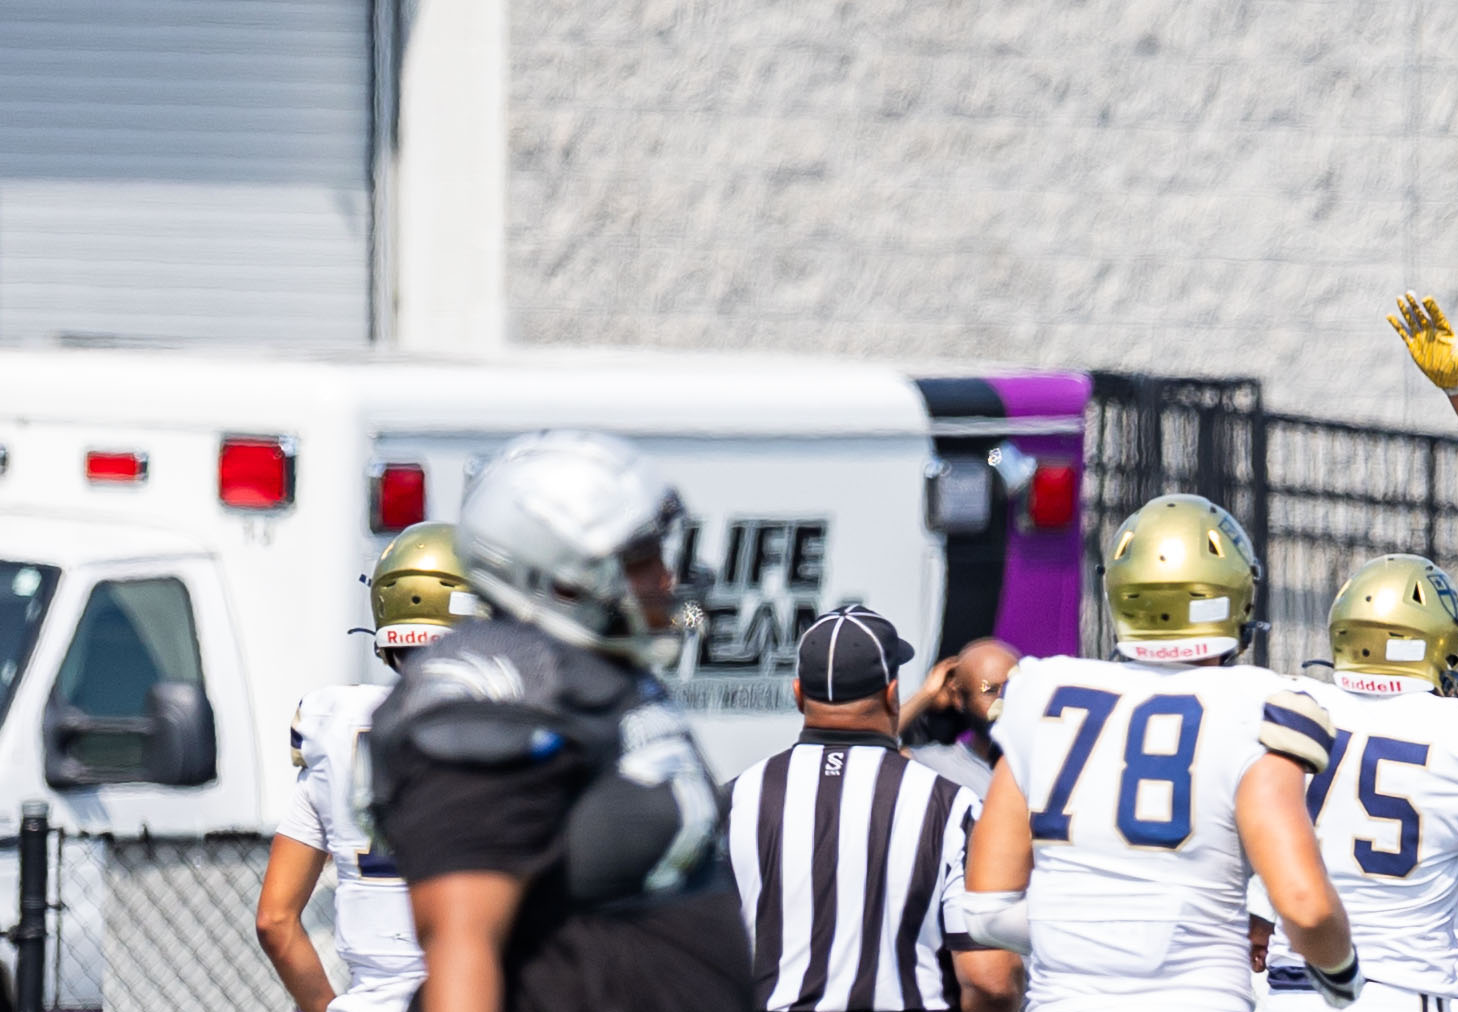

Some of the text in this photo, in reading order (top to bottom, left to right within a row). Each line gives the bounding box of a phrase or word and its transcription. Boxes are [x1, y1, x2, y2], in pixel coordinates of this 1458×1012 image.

[674, 519, 829, 588] LIFE
[386, 629, 441, 645] Ridde
[682, 598, 866, 671] EA
[1135, 642, 1208, 660] Riddell
[1341, 676, 1402, 693] Riddell
[1029, 685, 1205, 850] 78
[1305, 726, 1431, 880] 75
